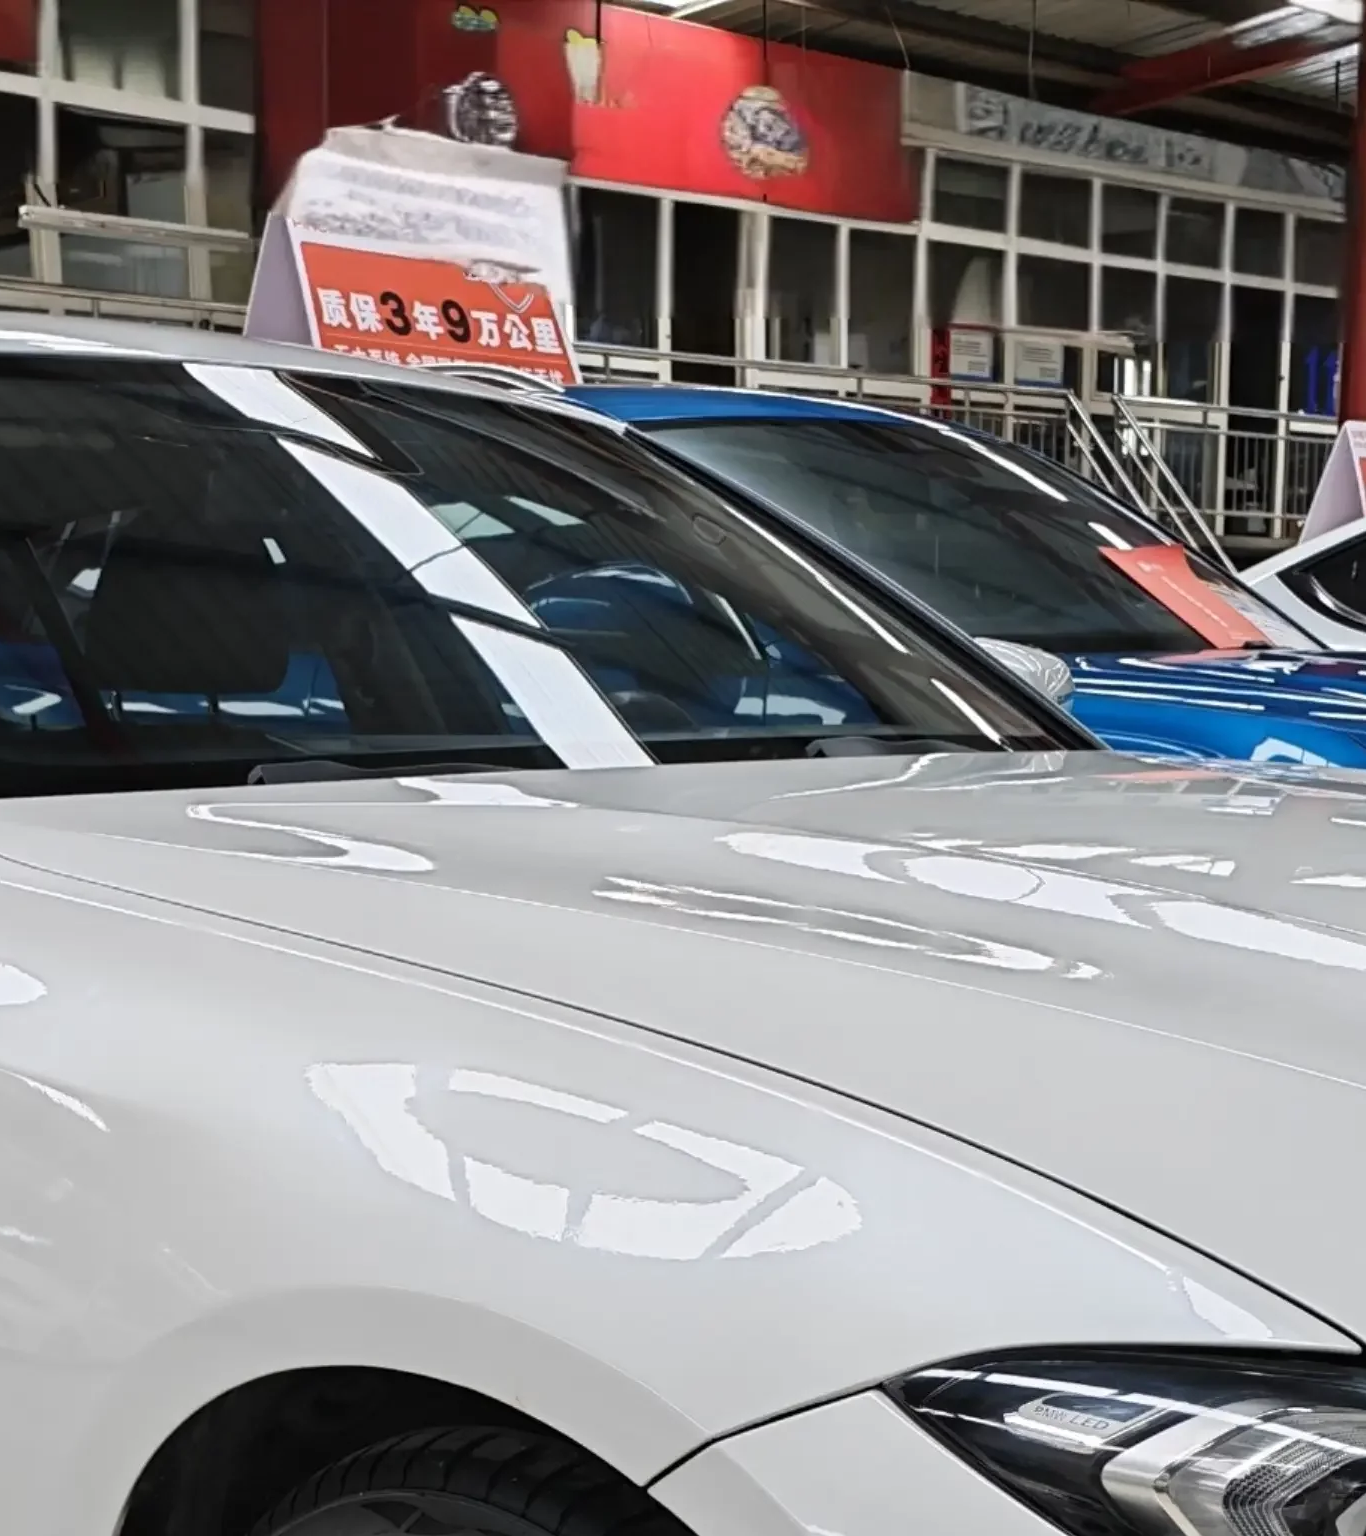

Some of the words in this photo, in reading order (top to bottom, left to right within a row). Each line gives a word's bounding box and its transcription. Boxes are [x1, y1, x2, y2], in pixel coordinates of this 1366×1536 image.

[316, 287, 563, 354] 质保3年9万公里
[1034, 1405, 1067, 1422] BMW
[1069, 1414, 1110, 1431] LED
